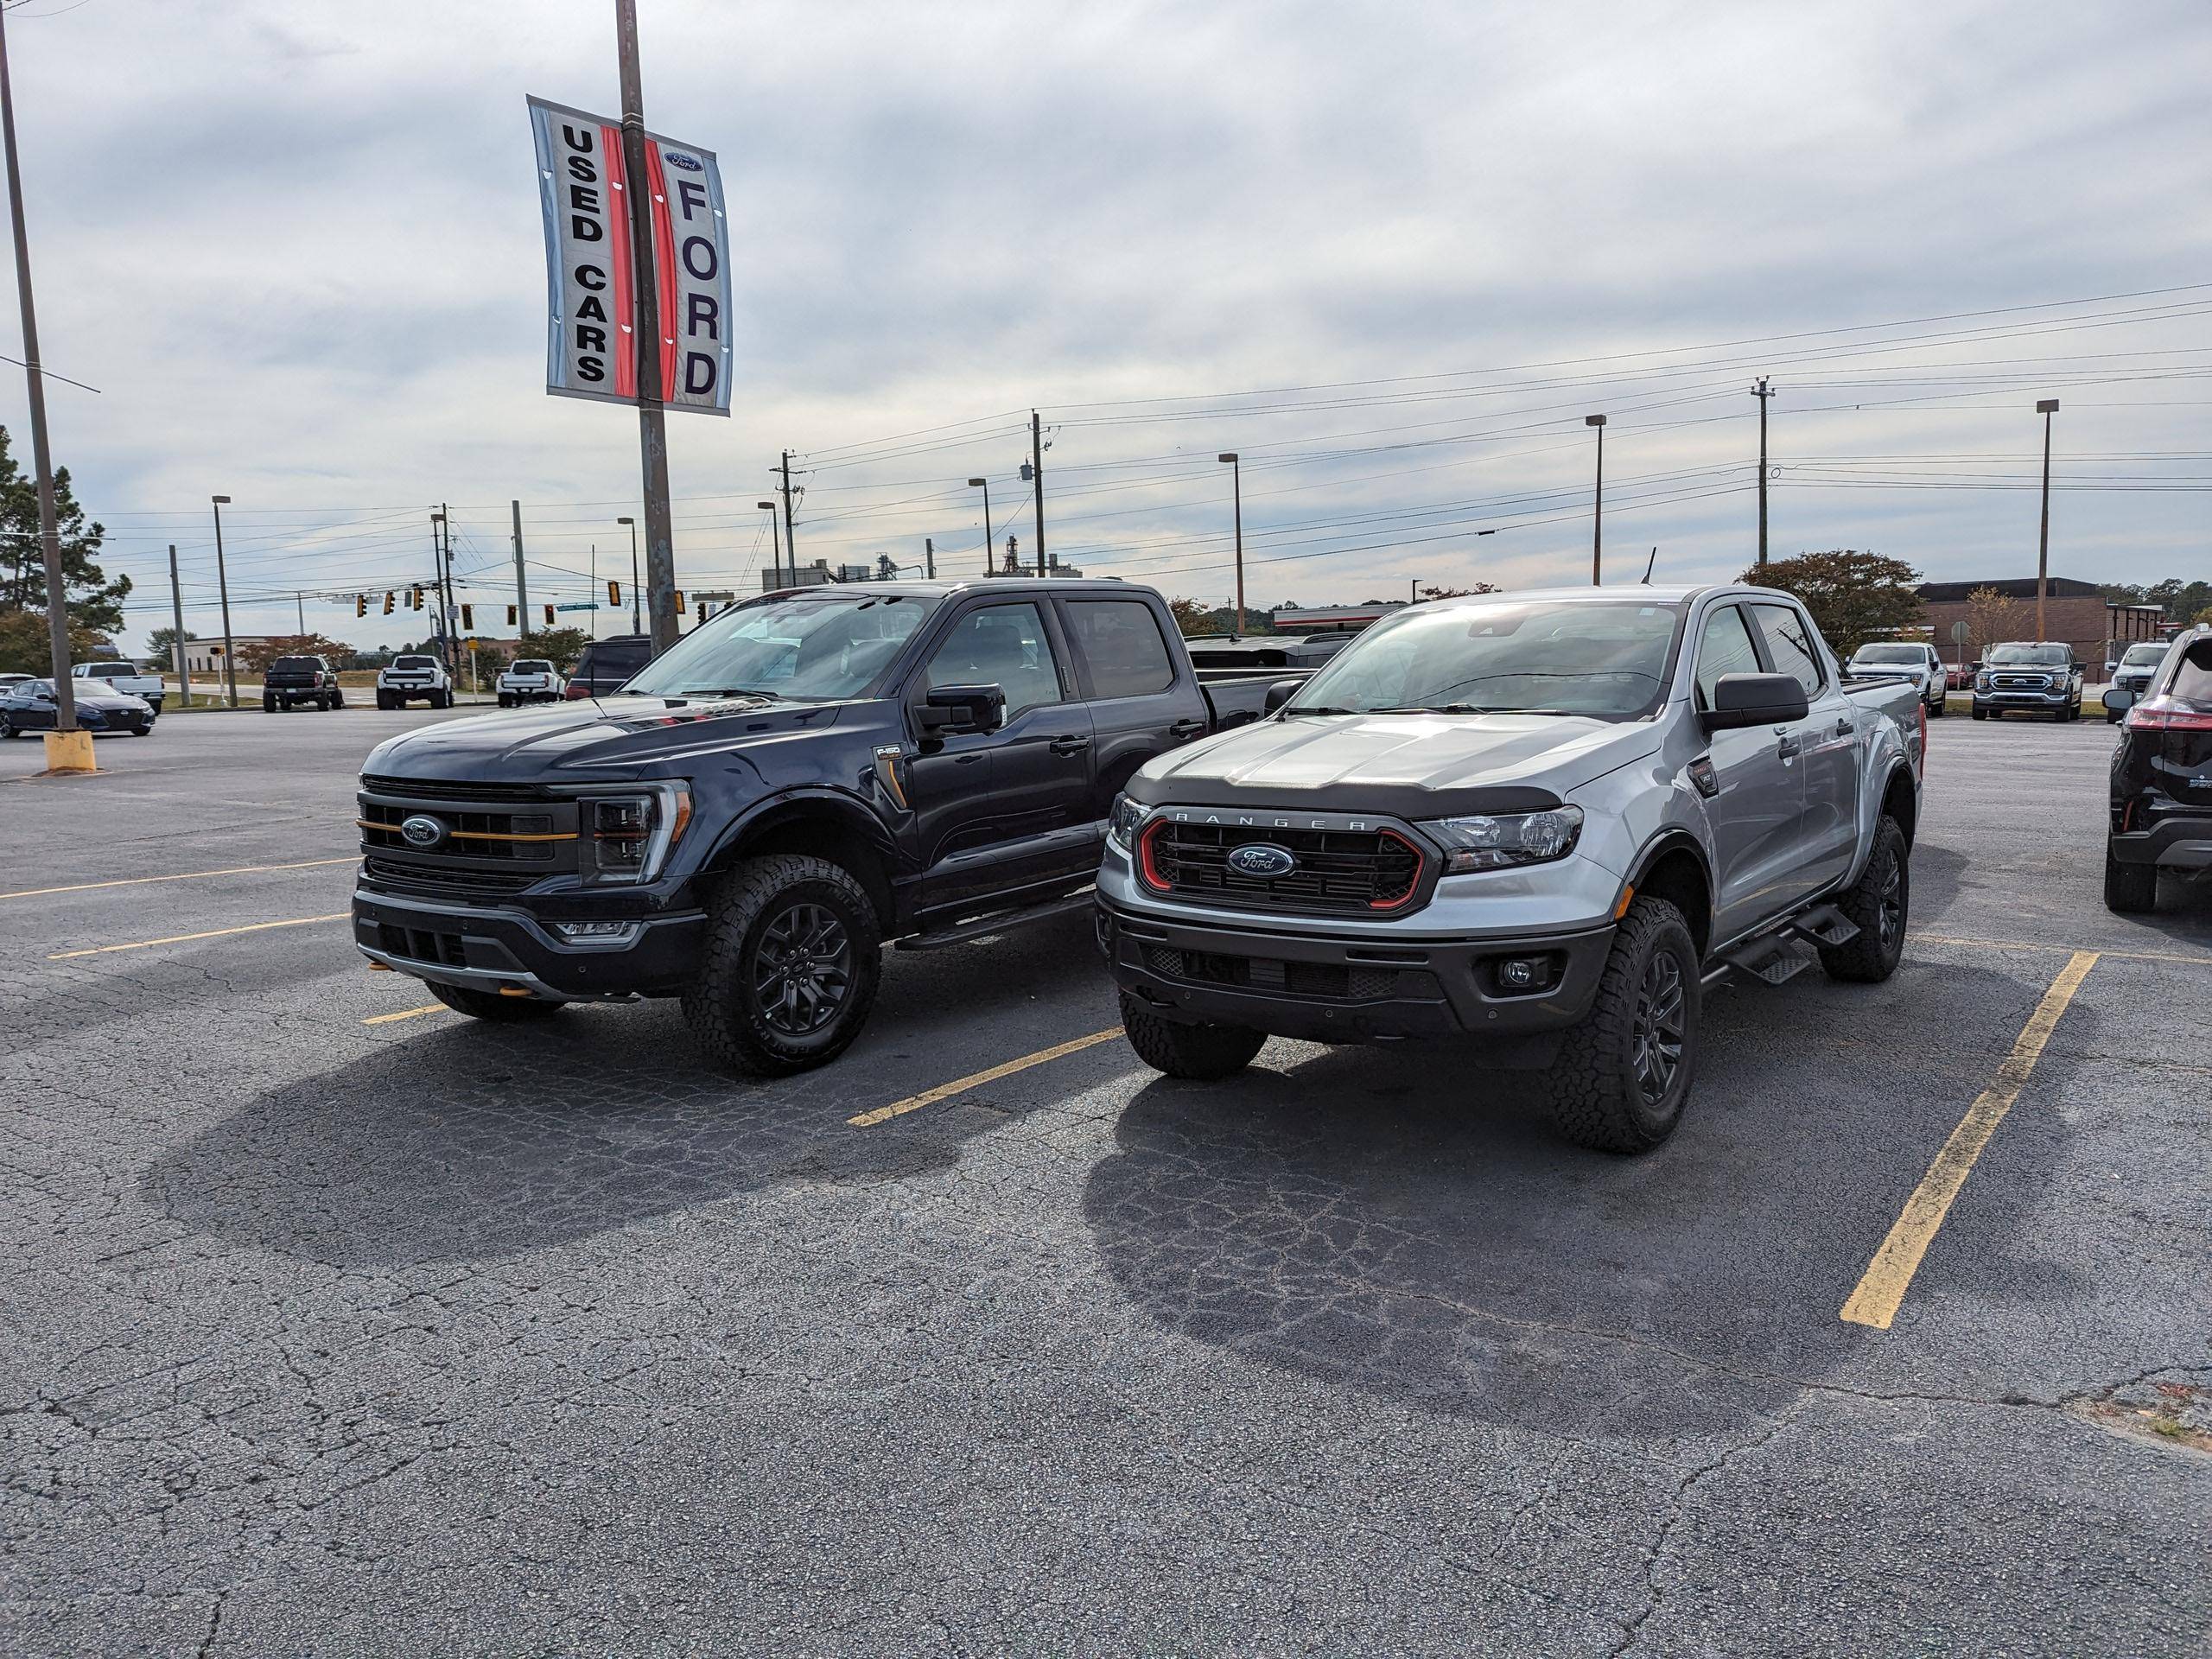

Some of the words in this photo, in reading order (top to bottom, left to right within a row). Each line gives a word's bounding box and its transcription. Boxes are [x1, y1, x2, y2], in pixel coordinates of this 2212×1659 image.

[671, 155, 696, 170] Ford
[563, 124, 603, 242] USED
[677, 179, 718, 396] FORD
[575, 264, 608, 382] CARS
[876, 746, 900, 755] F-150
[1176, 812, 1365, 830] RANGER
[408, 823, 429, 840] Ford
[1240, 850, 1275, 869] Ford
